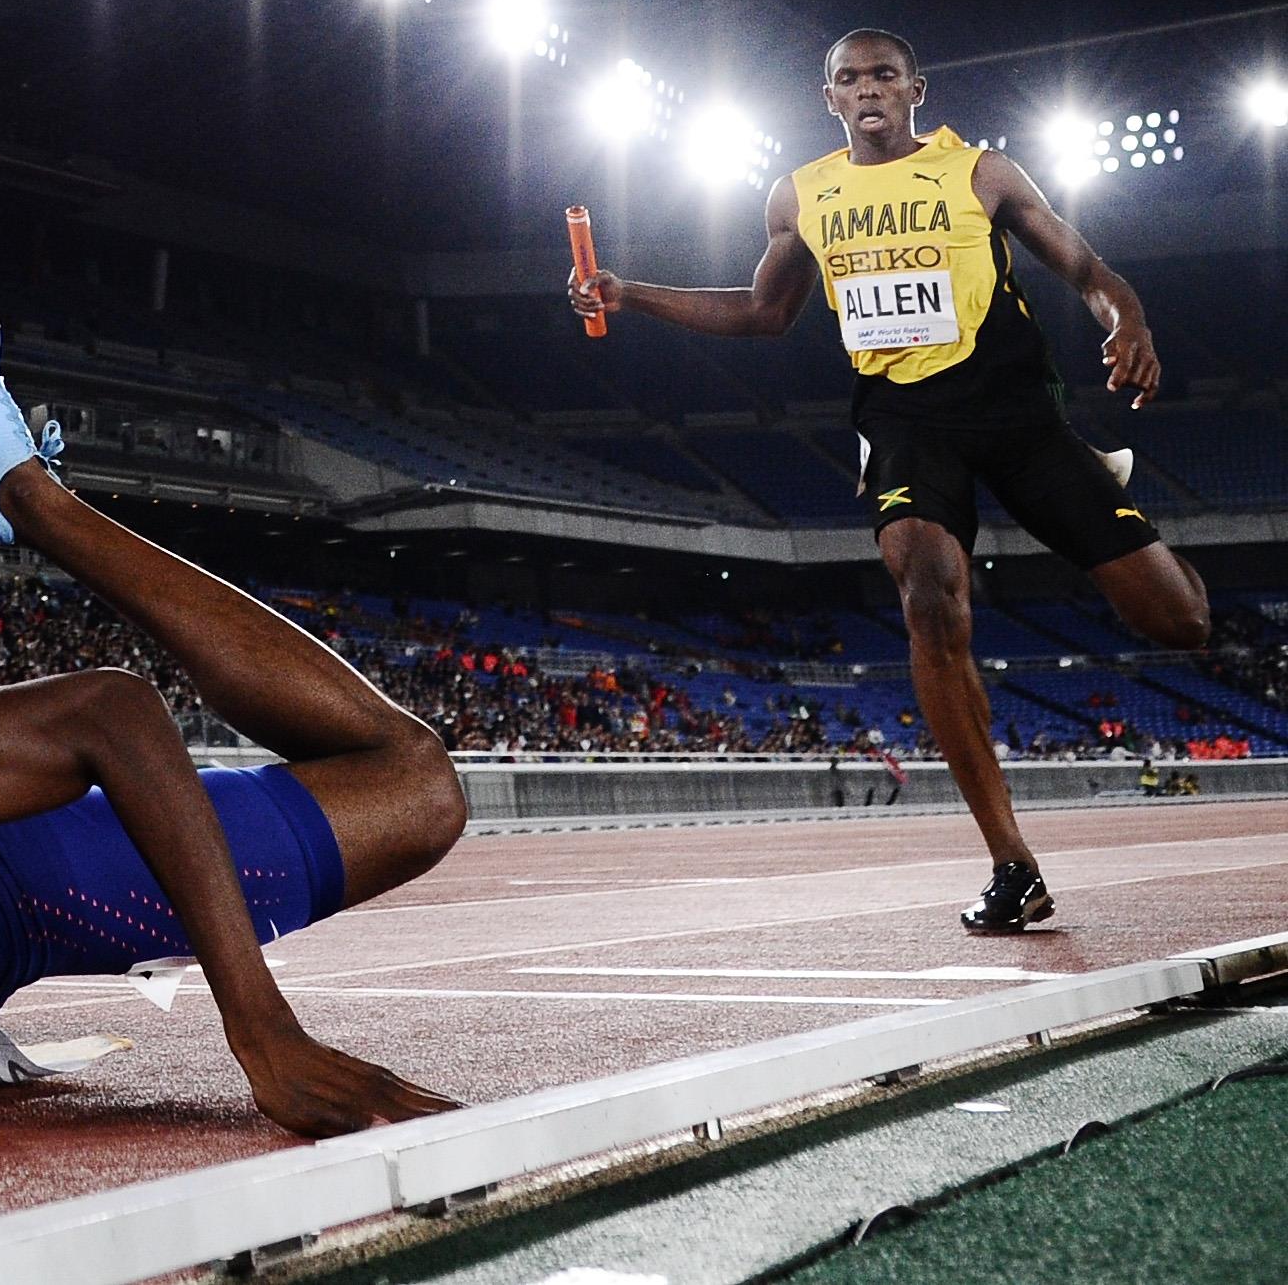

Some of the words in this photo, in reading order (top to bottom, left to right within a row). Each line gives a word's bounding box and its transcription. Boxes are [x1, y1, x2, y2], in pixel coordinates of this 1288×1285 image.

[822, 200, 951, 249] JAMAICA
[828, 245, 941, 277] SEIKO
[847, 281, 942, 321] ALLEN
